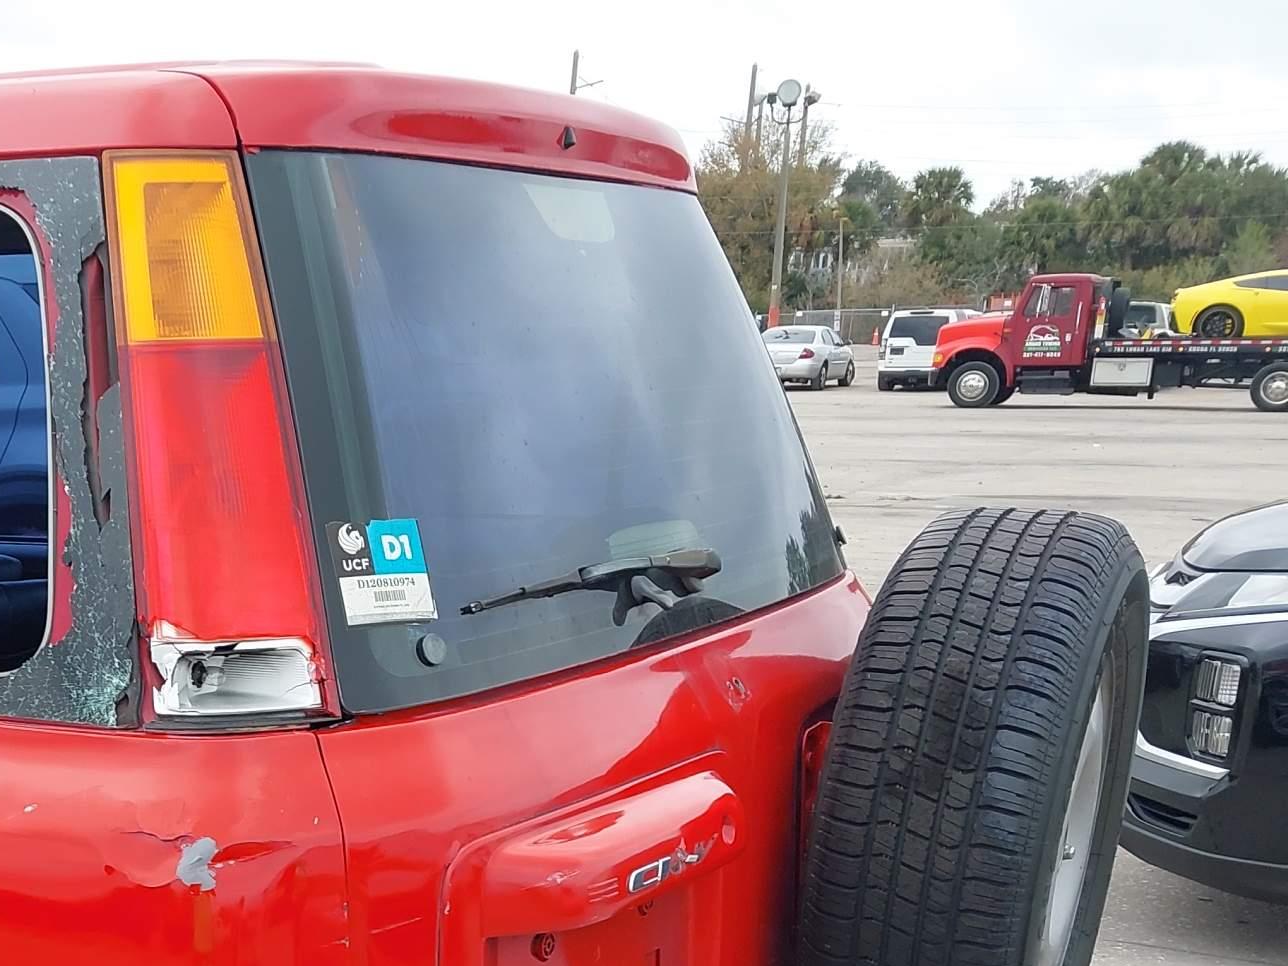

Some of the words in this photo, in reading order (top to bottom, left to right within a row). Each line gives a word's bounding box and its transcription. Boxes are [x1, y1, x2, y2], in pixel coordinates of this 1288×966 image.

[380, 534, 413, 561] D1
[342, 558, 370, 571] UCF
[357, 577, 416, 589] D120810974
